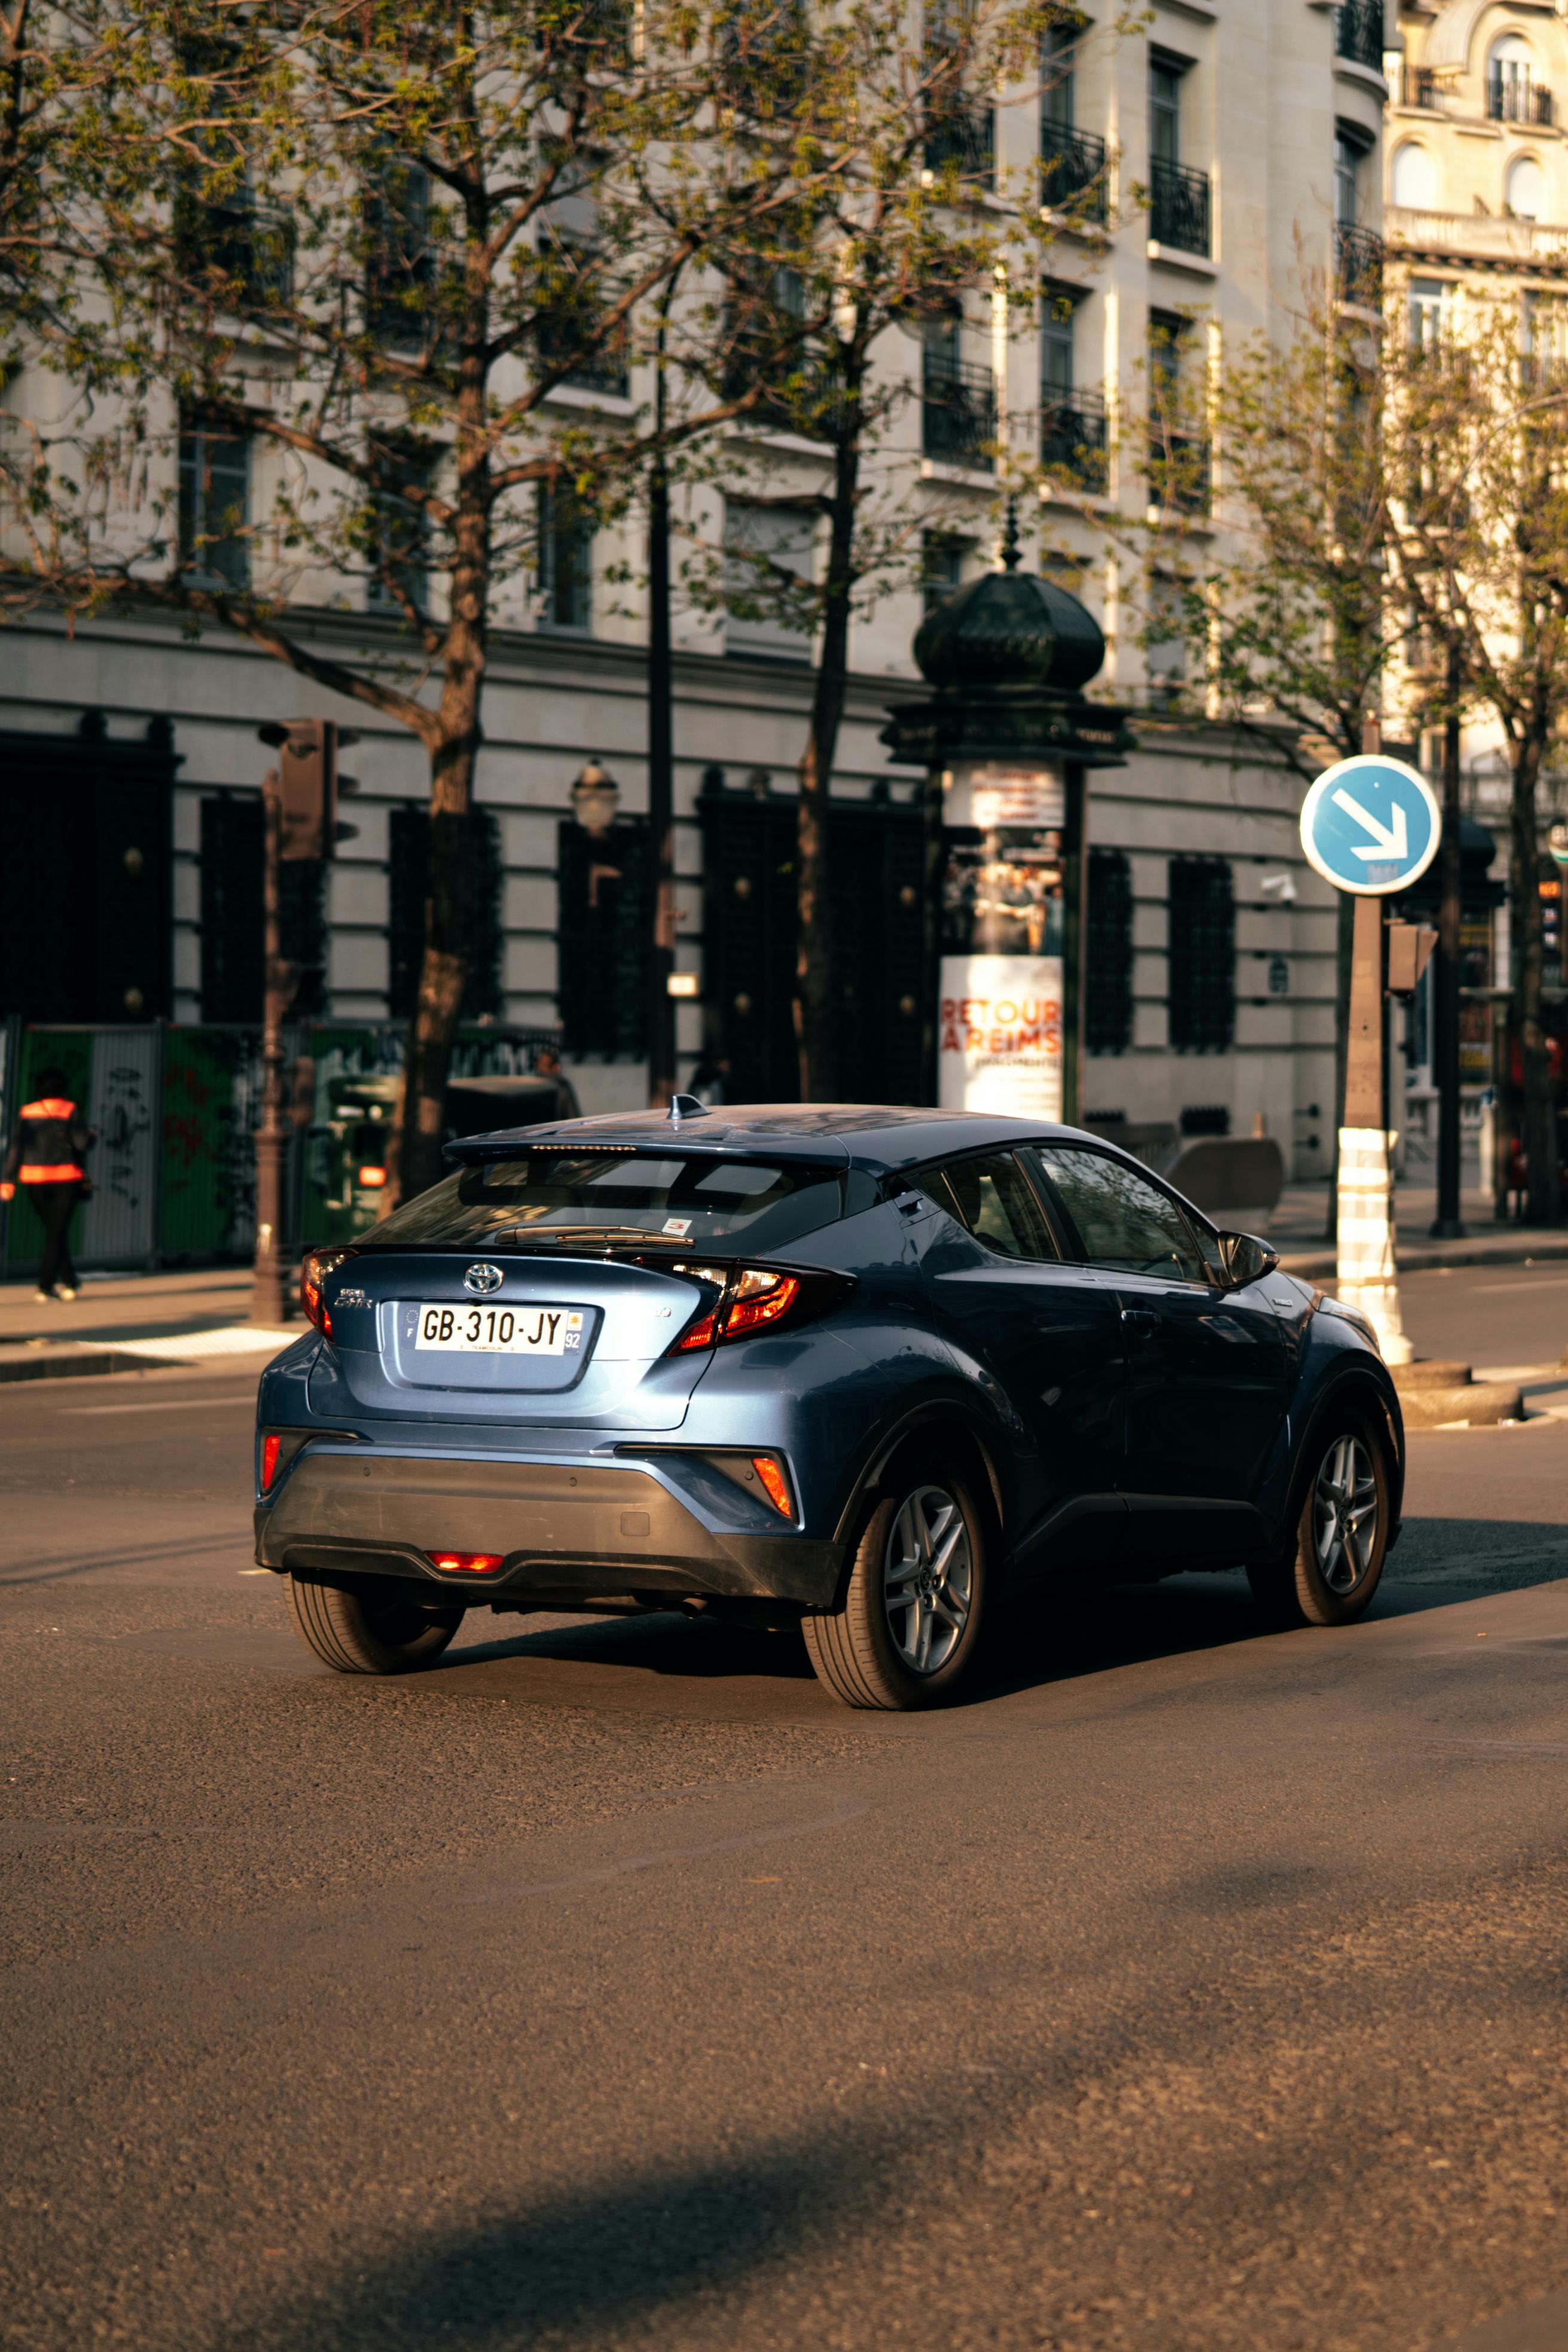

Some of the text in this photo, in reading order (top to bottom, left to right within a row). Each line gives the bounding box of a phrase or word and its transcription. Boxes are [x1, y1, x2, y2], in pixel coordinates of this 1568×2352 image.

[941, 998, 1063, 1026] RETOUR
[965, 1027, 1063, 1053] REIMS
[407, 1328, 414, 1337] F
[423, 1310, 562, 1345] GB-310-JY
[565, 1333, 581, 1349] 92
